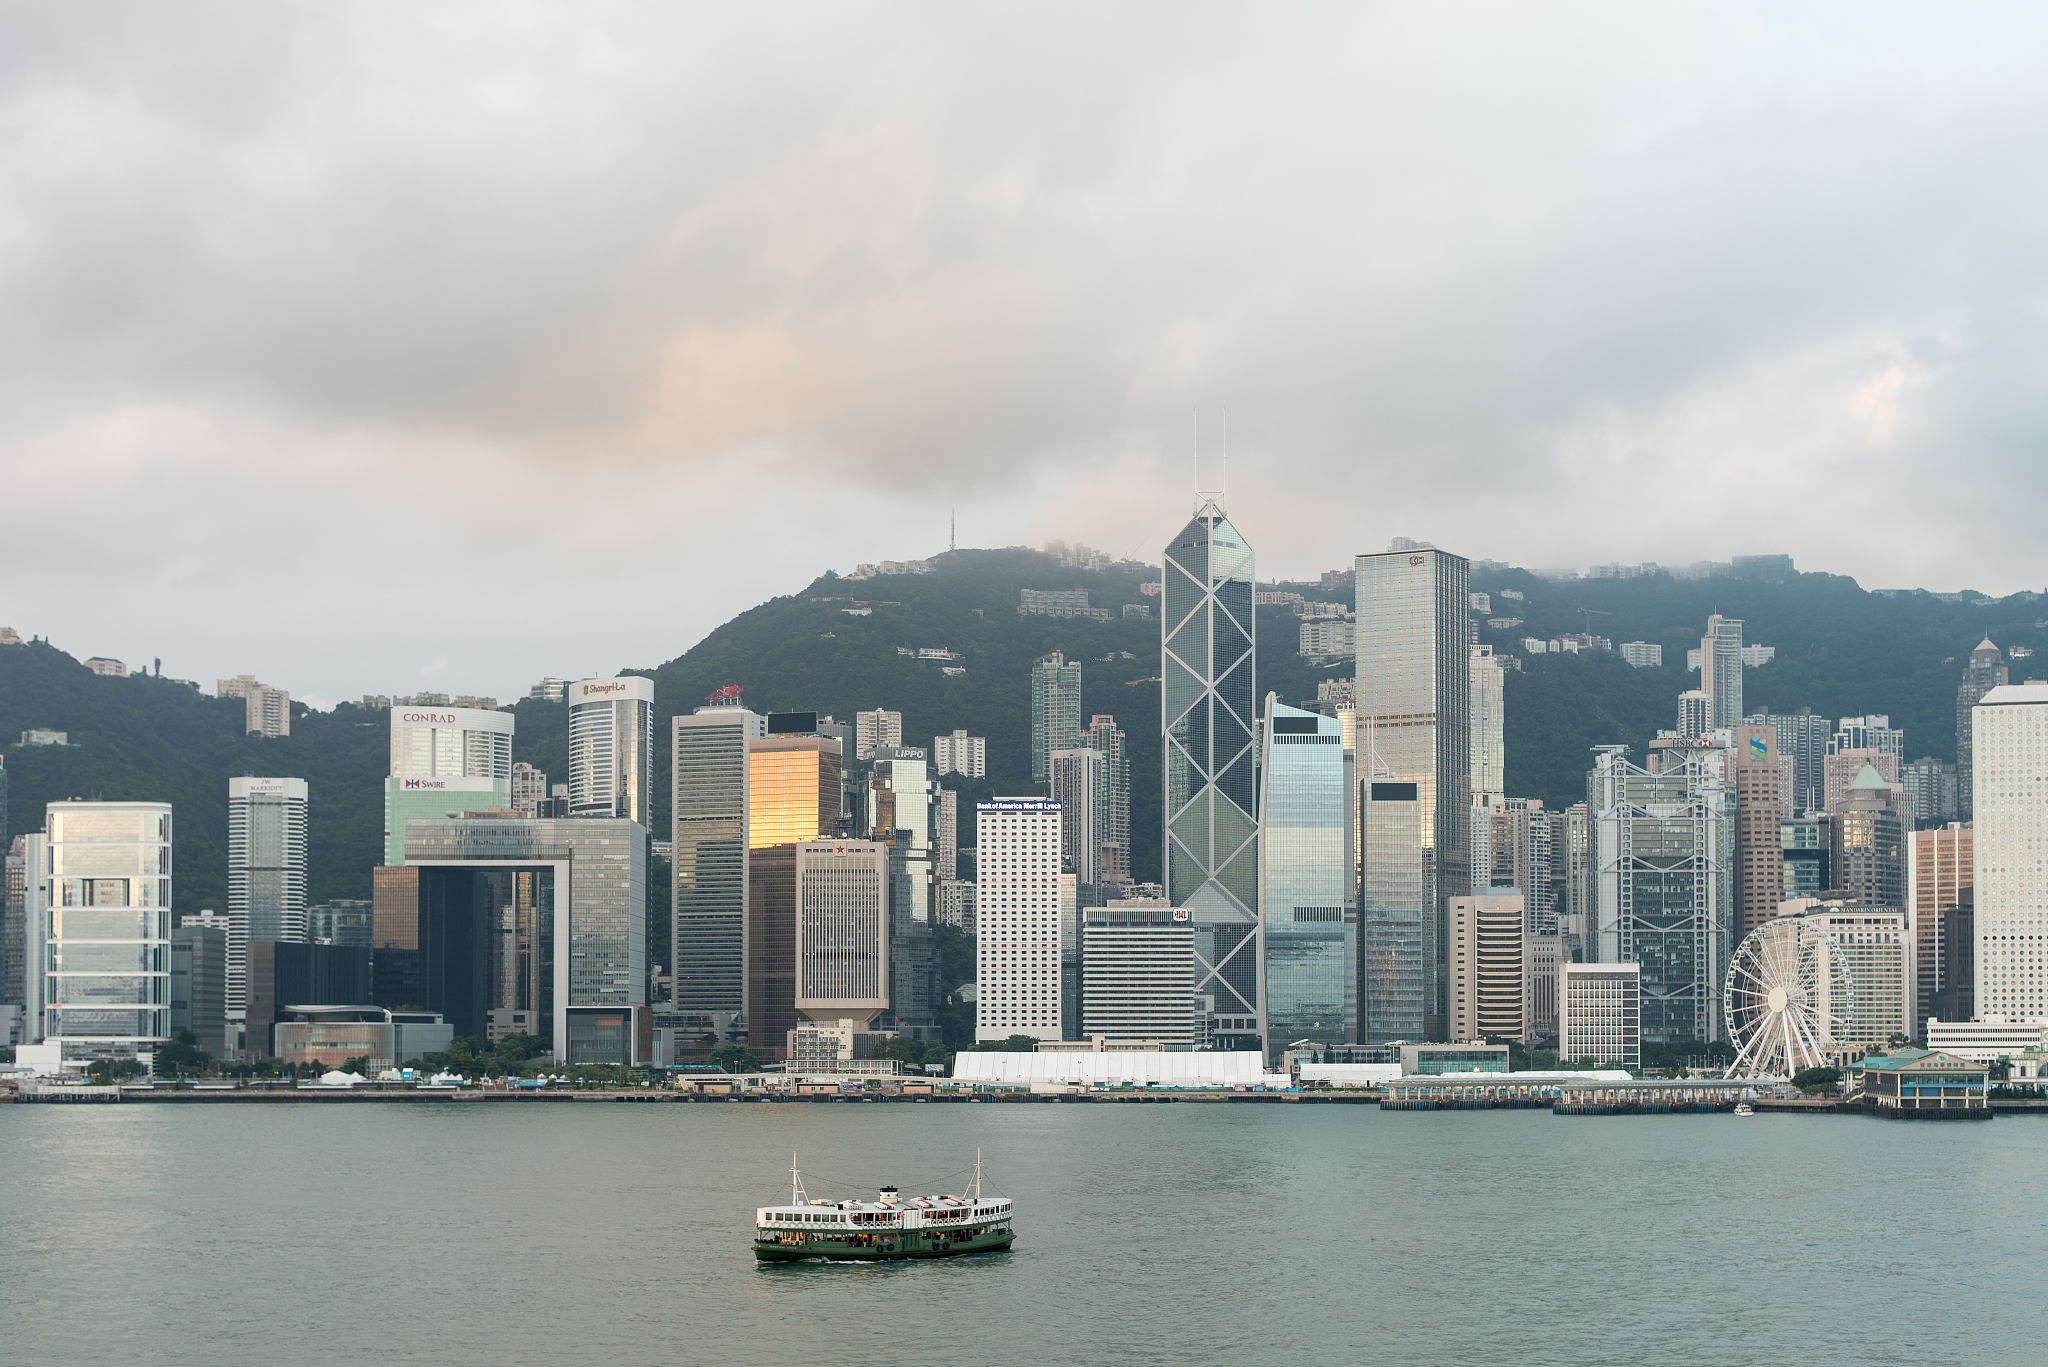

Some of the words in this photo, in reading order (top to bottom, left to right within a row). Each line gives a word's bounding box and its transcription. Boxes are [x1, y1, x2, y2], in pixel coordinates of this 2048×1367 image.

[589, 682, 626, 694] Shangri-La
[1335, 700, 1355, 712] citi
[403, 713, 456, 723] CONRAD
[894, 750, 924, 759] LIPPO
[976, 802, 991, 810] Bank
[998, 802, 1023, 810] America
[1023, 802, 1043, 810] Merrill
[1044, 802, 1062, 810] Lynch
